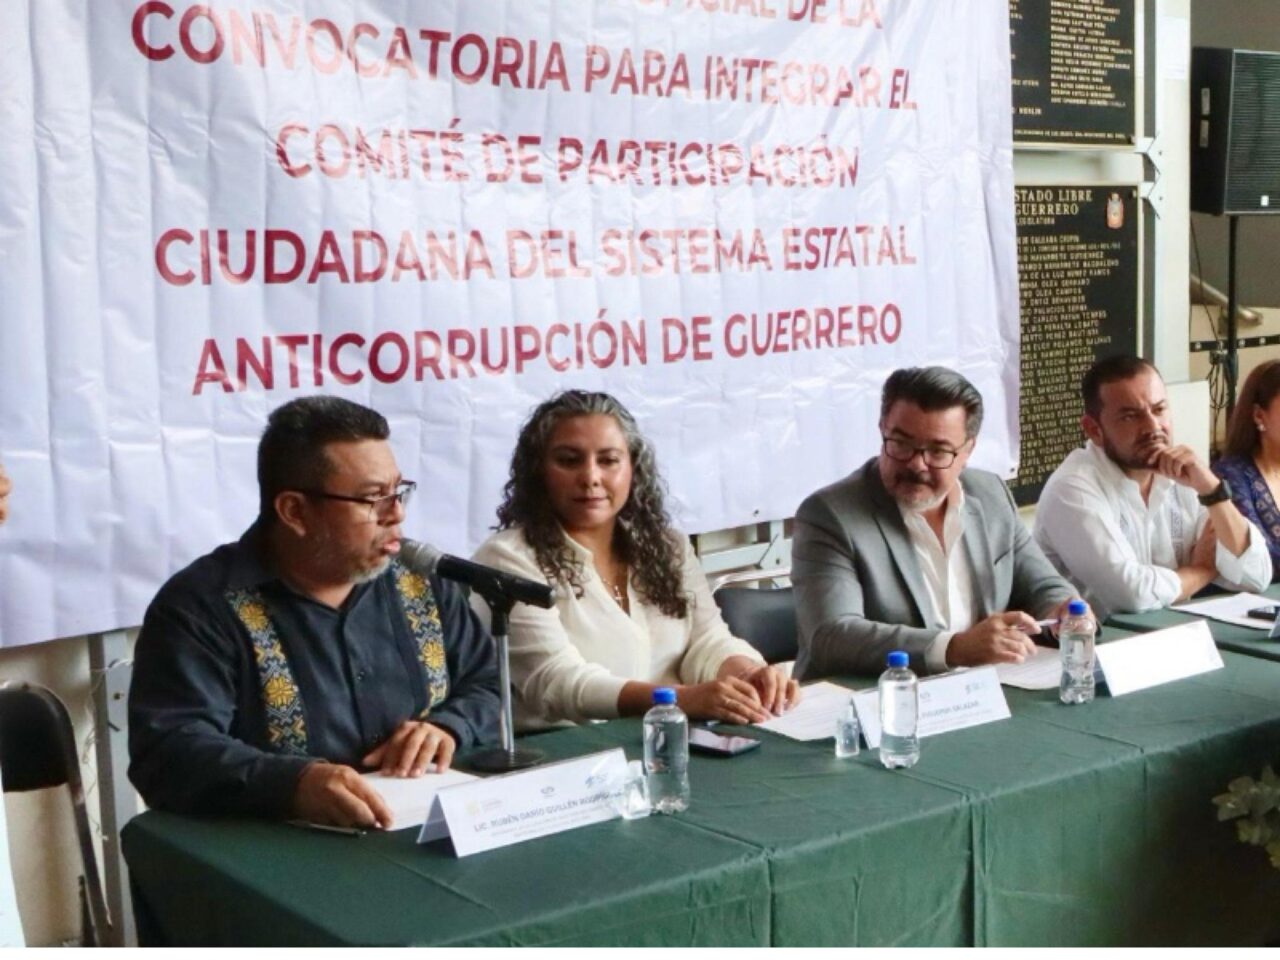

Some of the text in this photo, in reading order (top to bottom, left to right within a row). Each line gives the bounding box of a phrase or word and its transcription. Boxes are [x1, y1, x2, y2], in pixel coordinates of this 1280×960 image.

[132, 1, 917, 110] CONVOCATORIA PARA INTEGRAR EL
[277, 119, 859, 190] COMITÉ DE PARTICIPACIÓN
[1015, 190, 1092, 202] STADO LIBRE
[1015, 203, 1079, 215] GUERRERO
[154, 225, 916, 287] CIUDADANA DEL SISTEMA ESTATAL
[193, 303, 903, 396] ANTICORRUPCIÓN DE GUERRERO
